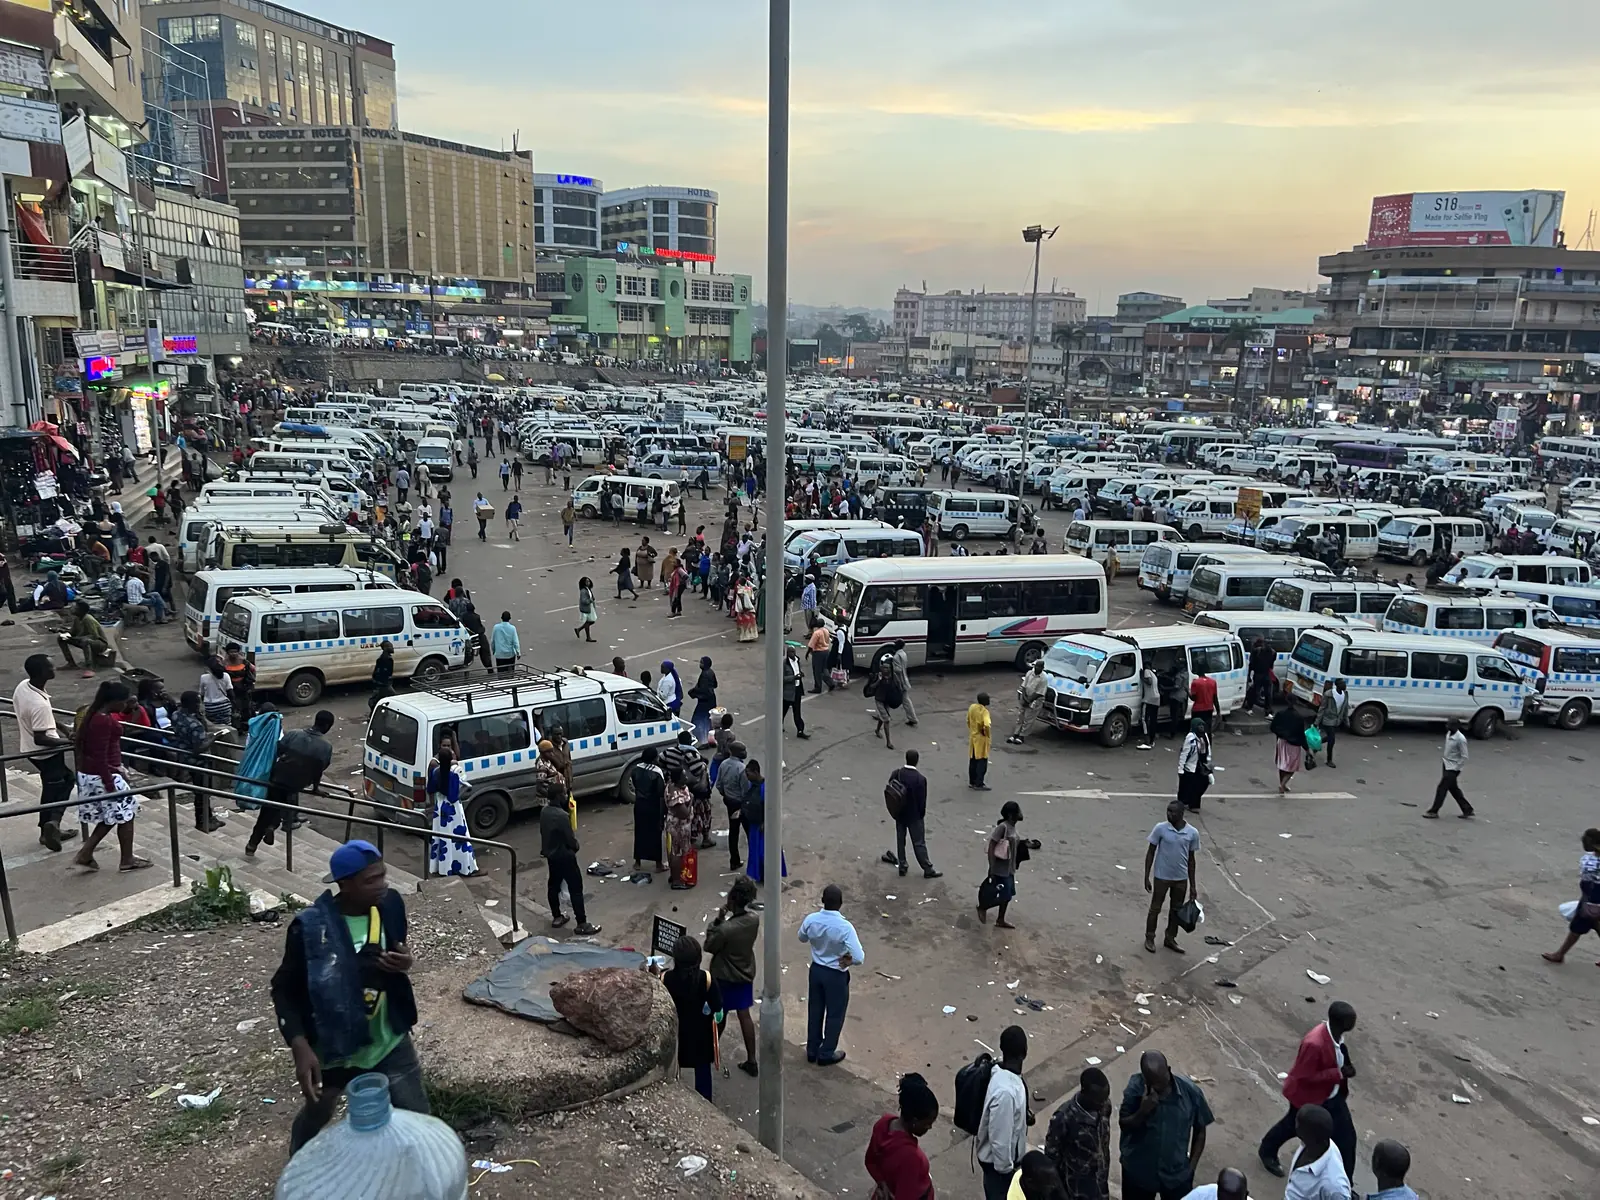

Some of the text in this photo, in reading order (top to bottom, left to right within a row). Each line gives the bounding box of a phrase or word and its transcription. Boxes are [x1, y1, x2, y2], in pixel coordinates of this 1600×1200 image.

[687, 188, 711, 197] HOTEL
[1434, 197, 1458, 211] S18
[1424, 213, 1442, 221] Made
[1443, 213, 1453, 221] for
[1400, 251, 1434, 259] PLAZA
